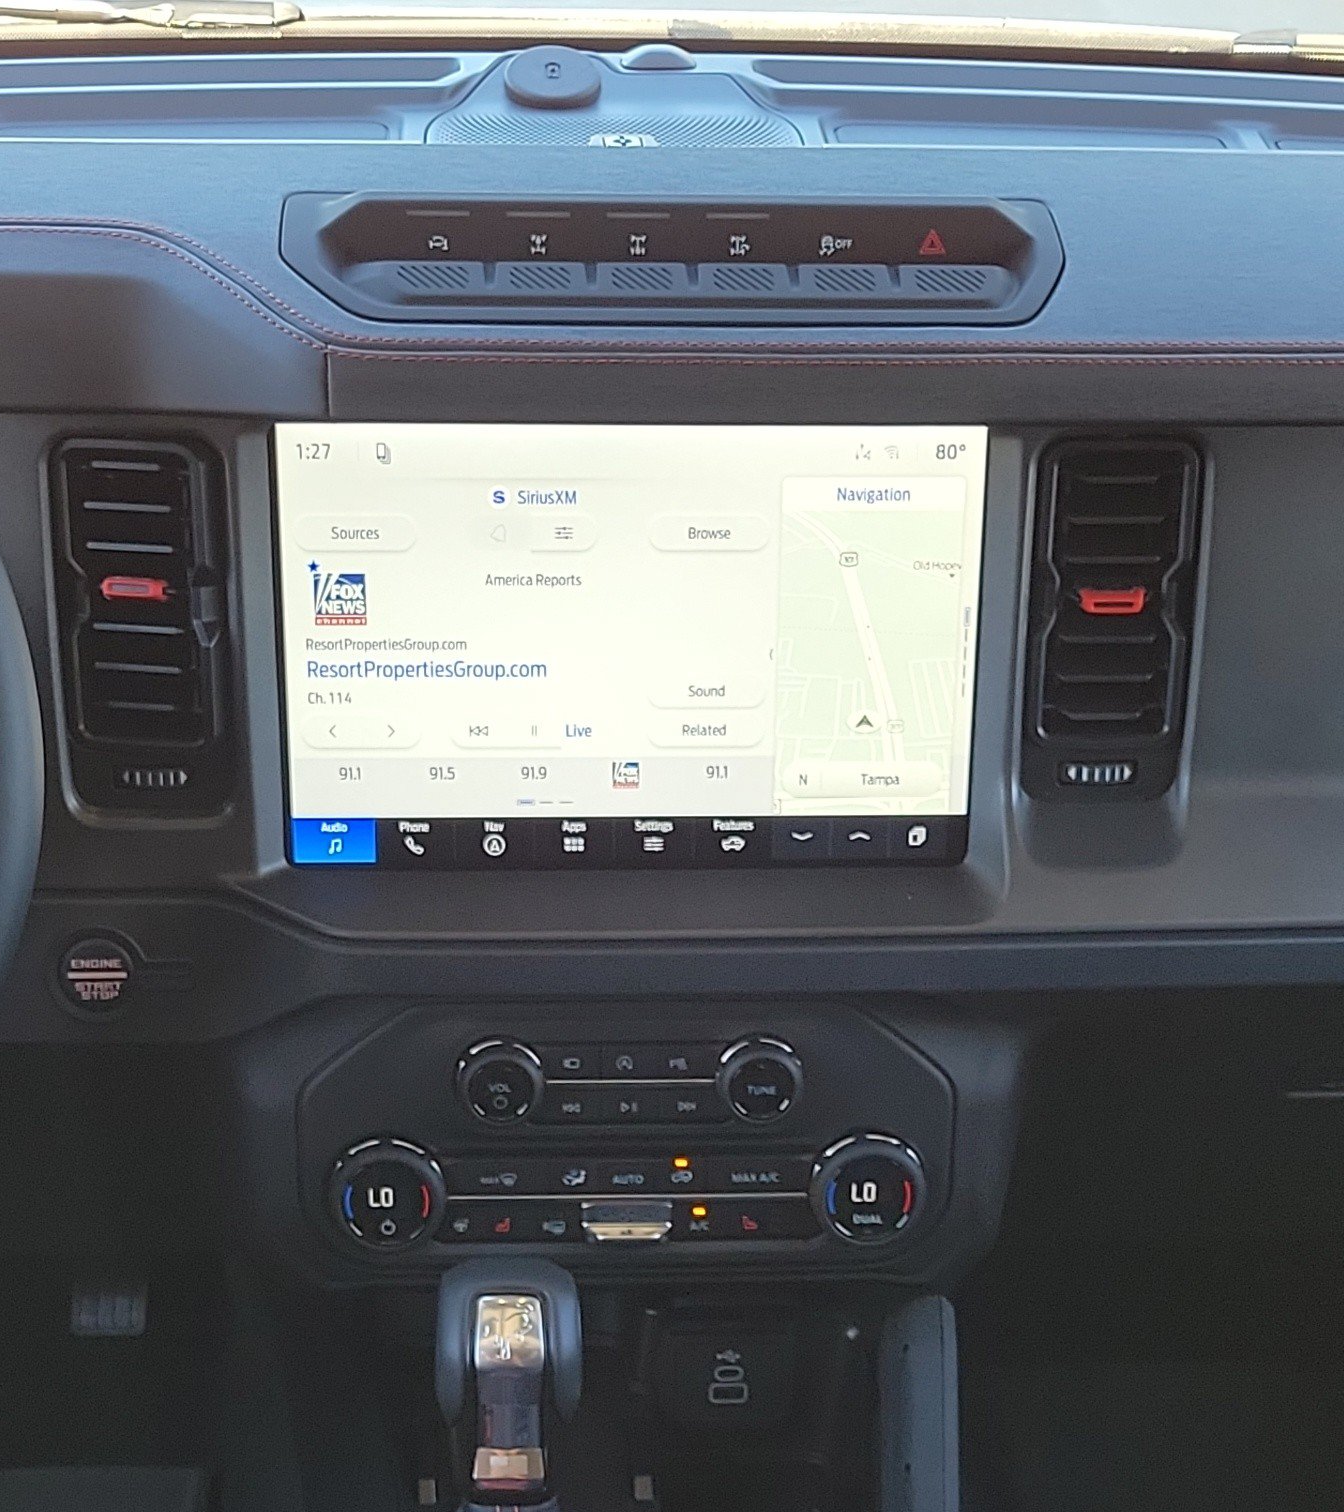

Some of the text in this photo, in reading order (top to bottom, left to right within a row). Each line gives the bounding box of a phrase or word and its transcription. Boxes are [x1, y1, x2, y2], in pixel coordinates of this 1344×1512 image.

[835, 239, 853, 249] OFF
[295, 444, 330, 460] 1:27
[935, 444, 966, 460] 80°
[518, 490, 577, 505] SiriusXM
[837, 487, 911, 503] Navigation
[331, 527, 380, 540] Sources
[688, 527, 731, 540] Browse
[485, 574, 582, 588] America Reports
[330, 584, 364, 599] FOX
[321, 600, 366, 614] NEWS
[306, 638, 467, 652] ResortPropertiesGroup.com
[307, 660, 547, 681] ResortPropertiesGroup.com
[688, 685, 725, 697] Sound
[307, 692, 352, 704] Ch. 114
[565, 725, 592, 738] Live
[682, 725, 726, 736] Related
[338, 767, 361, 780] 91.1
[429, 767, 455, 780] 91.5
[521, 767, 547, 780] 91.9
[706, 766, 728, 779] 91.1
[799, 774, 808, 786] N
[861, 773, 900, 787] Tampa
[321, 822, 348, 833] Audio
[399, 821, 430, 833] Phone
[484, 821, 504, 832] Nav
[562, 821, 587, 833] Apps
[634, 820, 675, 833] Settings
[71, 959, 123, 969] ENGINE
[367, 1187, 394, 1208] LO
[851, 1181, 878, 1203] LO
